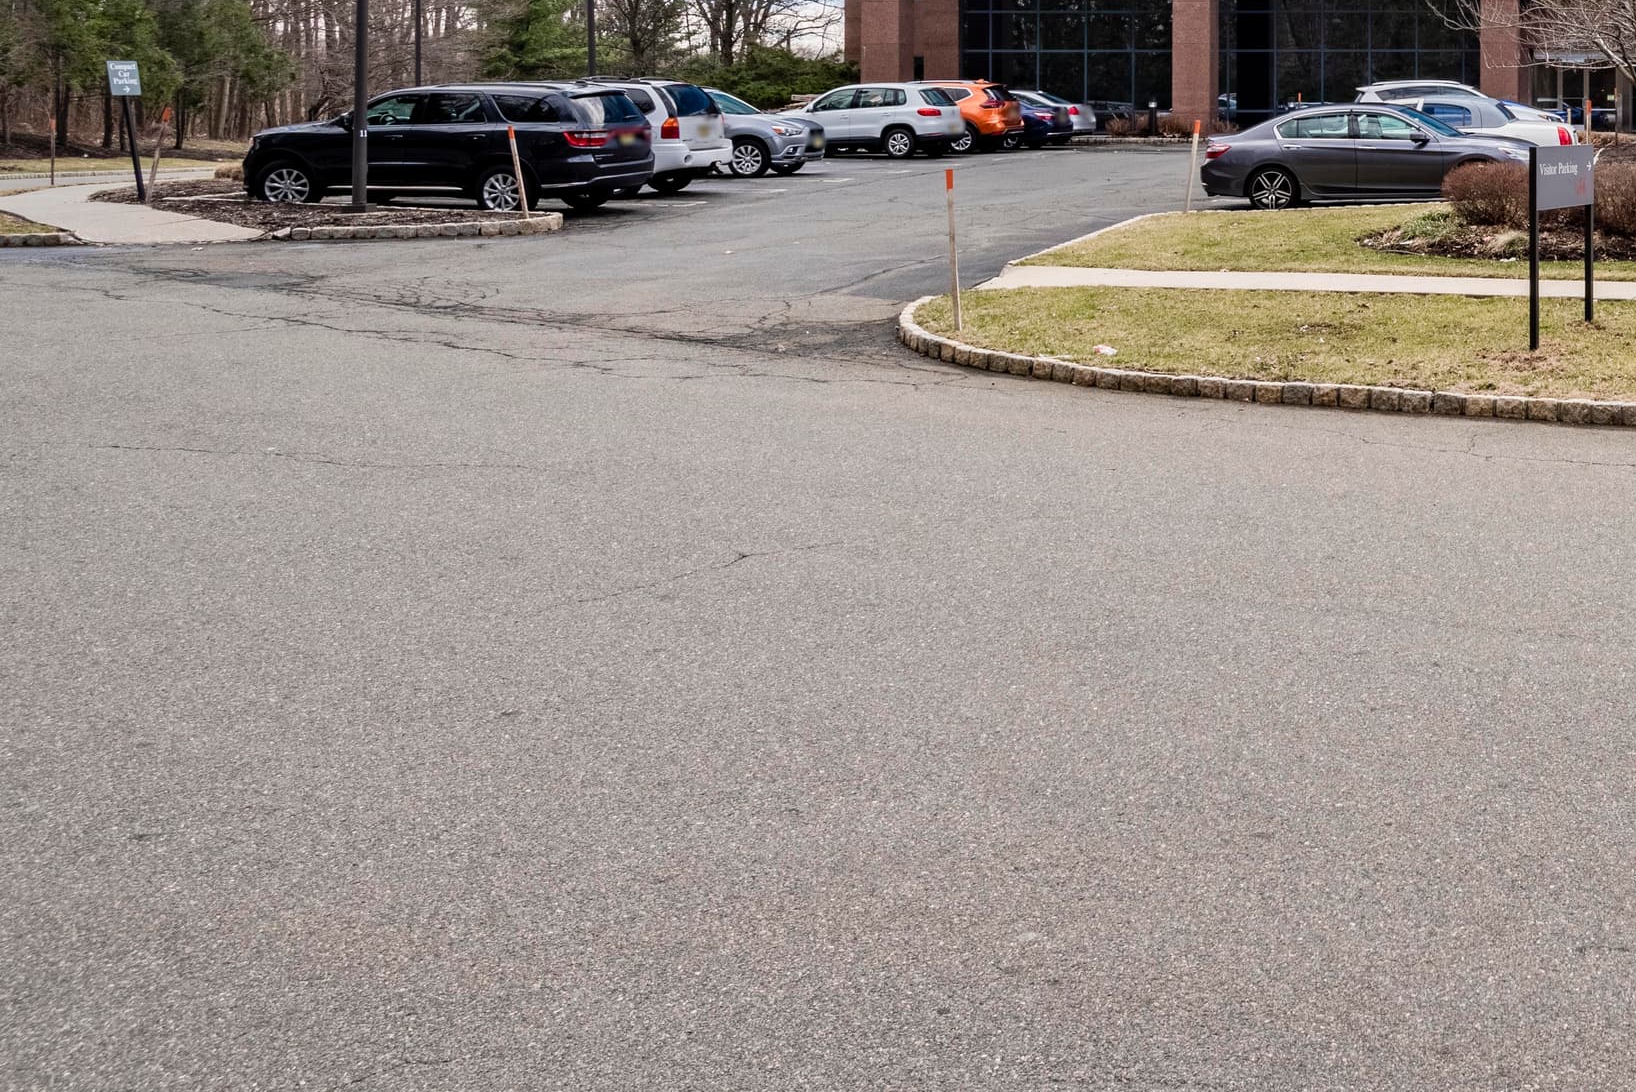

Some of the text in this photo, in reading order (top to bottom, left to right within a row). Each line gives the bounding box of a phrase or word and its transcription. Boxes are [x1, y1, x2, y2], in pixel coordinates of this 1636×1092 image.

[112, 76, 138, 85] Parking
[359, 129, 368, 138] 11
[1539, 161, 1578, 175] Visitor Parking
